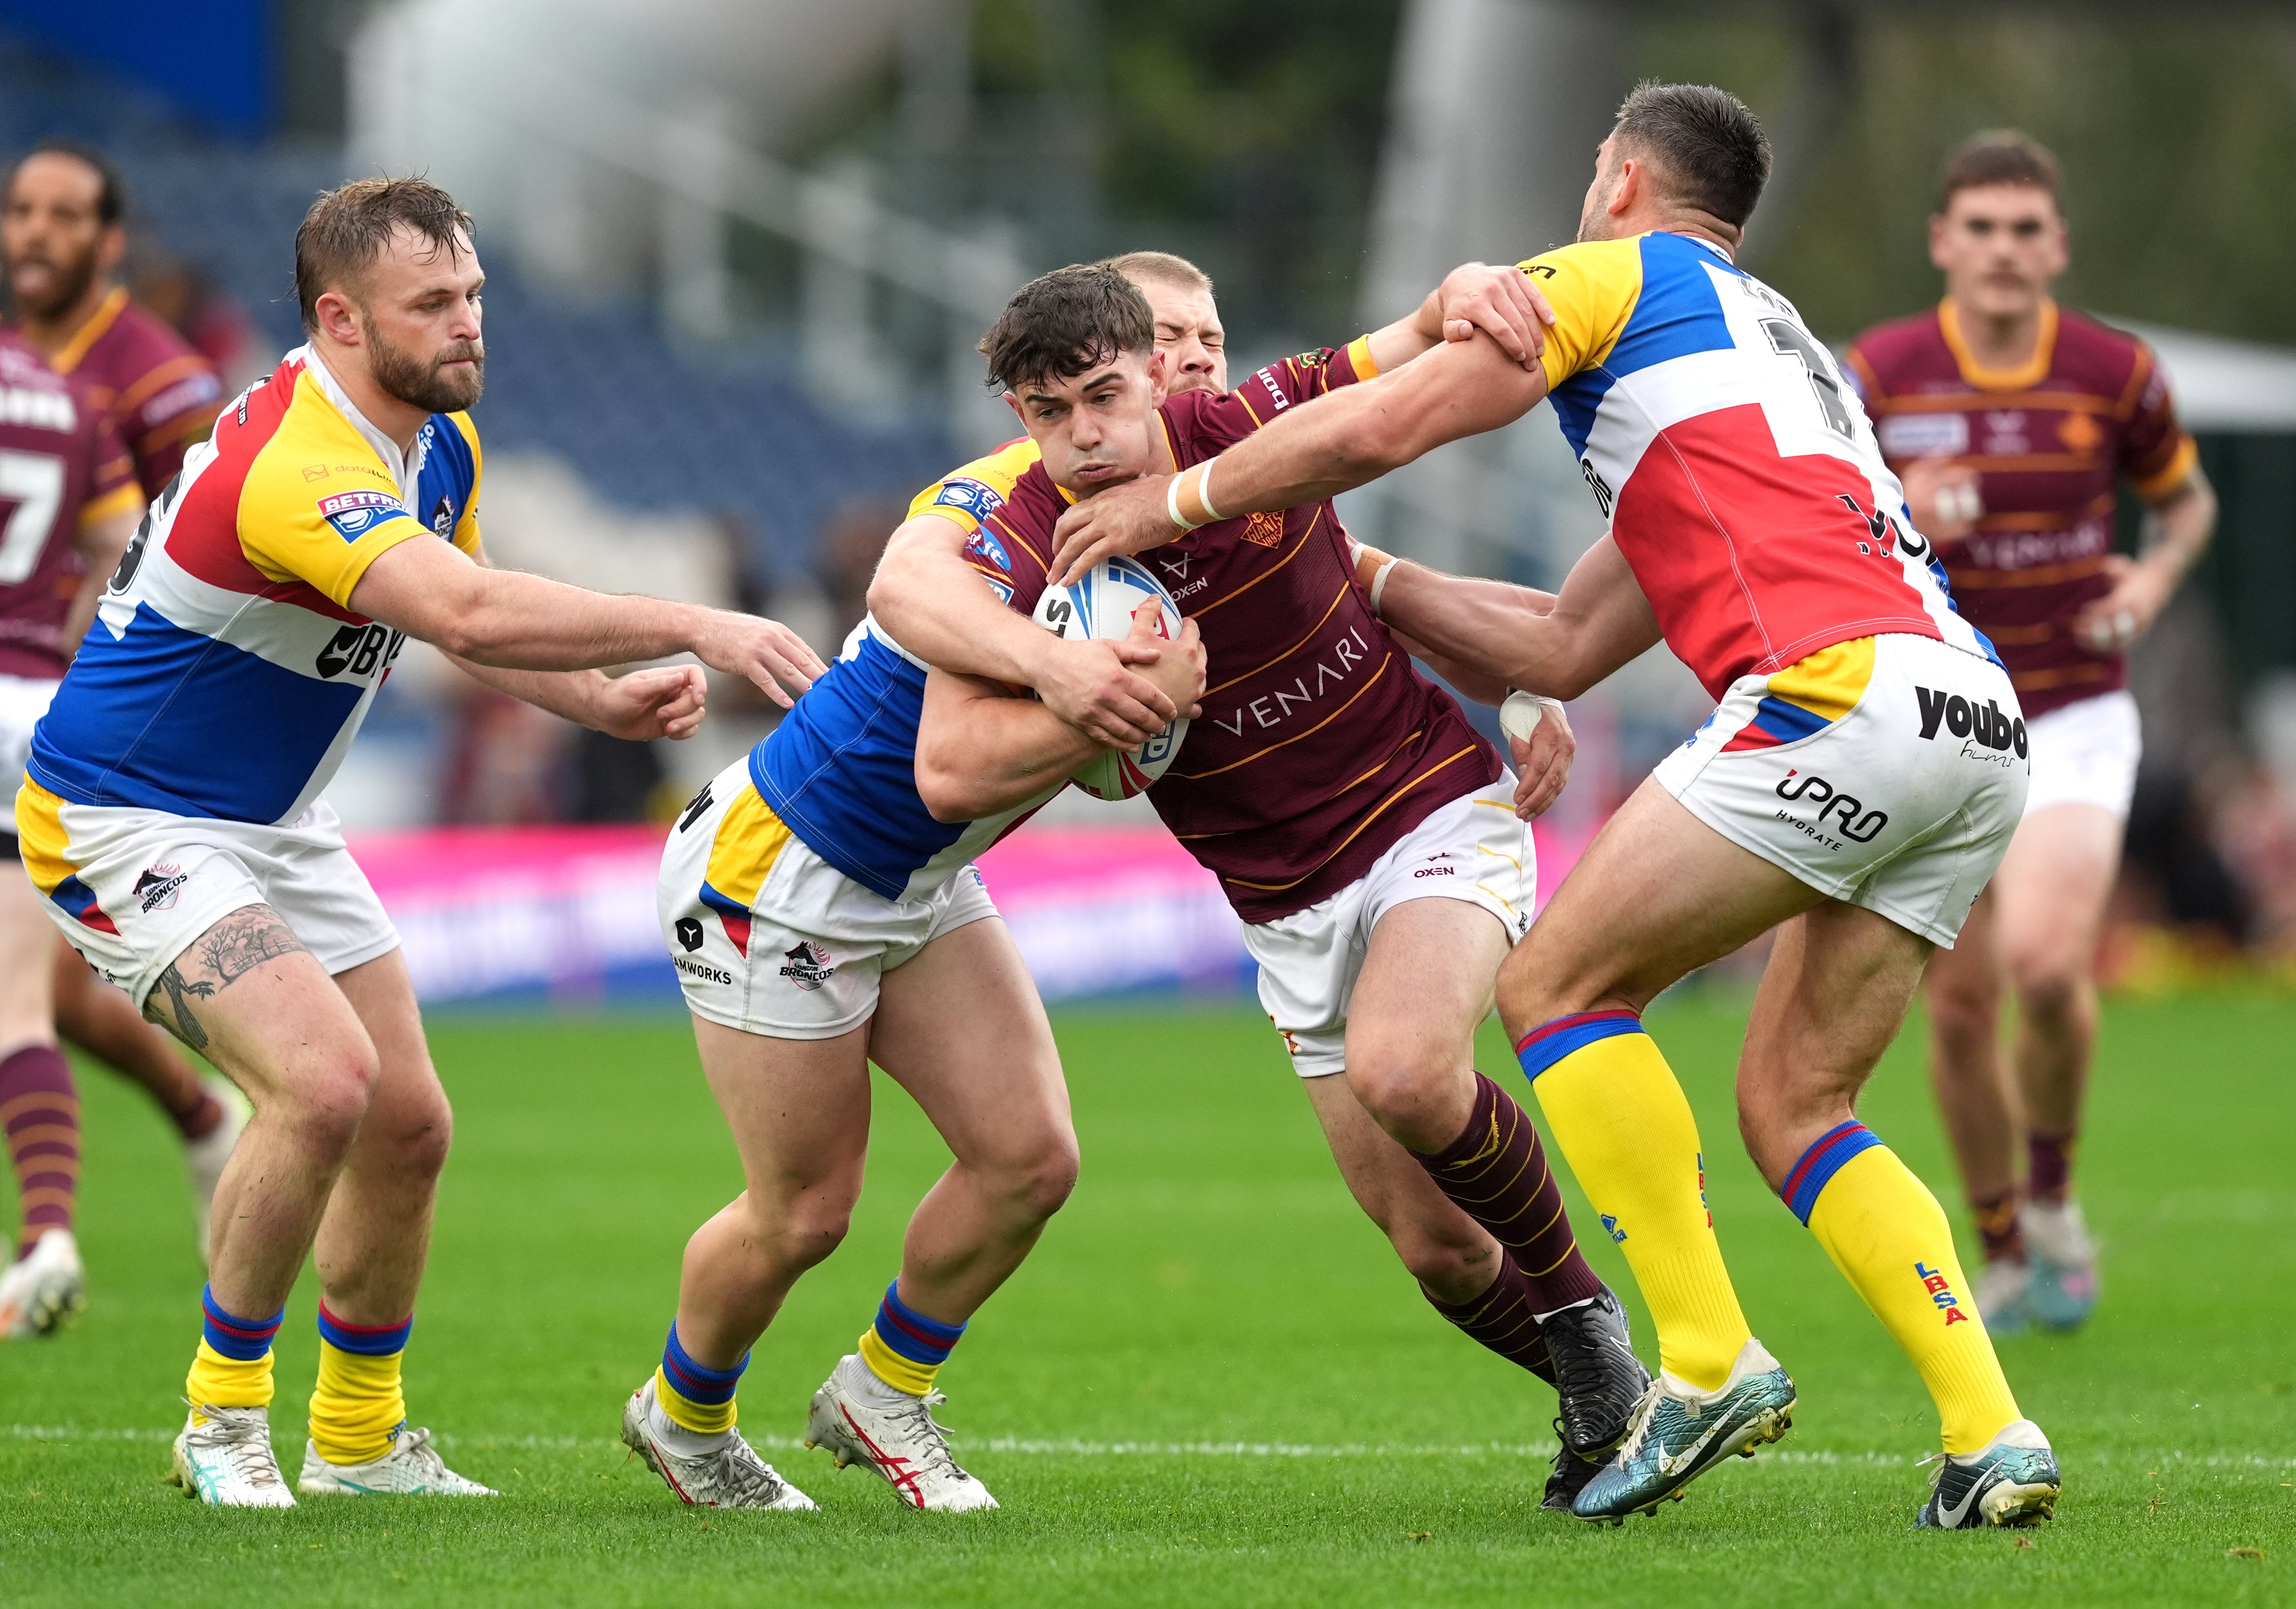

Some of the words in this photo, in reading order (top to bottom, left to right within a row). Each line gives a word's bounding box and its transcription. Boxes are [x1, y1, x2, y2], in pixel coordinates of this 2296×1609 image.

[1247, 513, 1283, 542] GIANTS
[1171, 577, 1208, 601] OXEN
[1915, 686, 2030, 766] youbo
[1776, 809, 1843, 851] HYDRATE
[1414, 867, 1455, 878] OXEN
[142, 872, 187, 914] BRONCOS
[146, 878, 171, 897] LONDON
[670, 952, 731, 985] AMWORKS
[779, 968, 834, 982] BRONCOS
[795, 963, 818, 971] LONDON
[1914, 1262, 1968, 1326] LBSA
